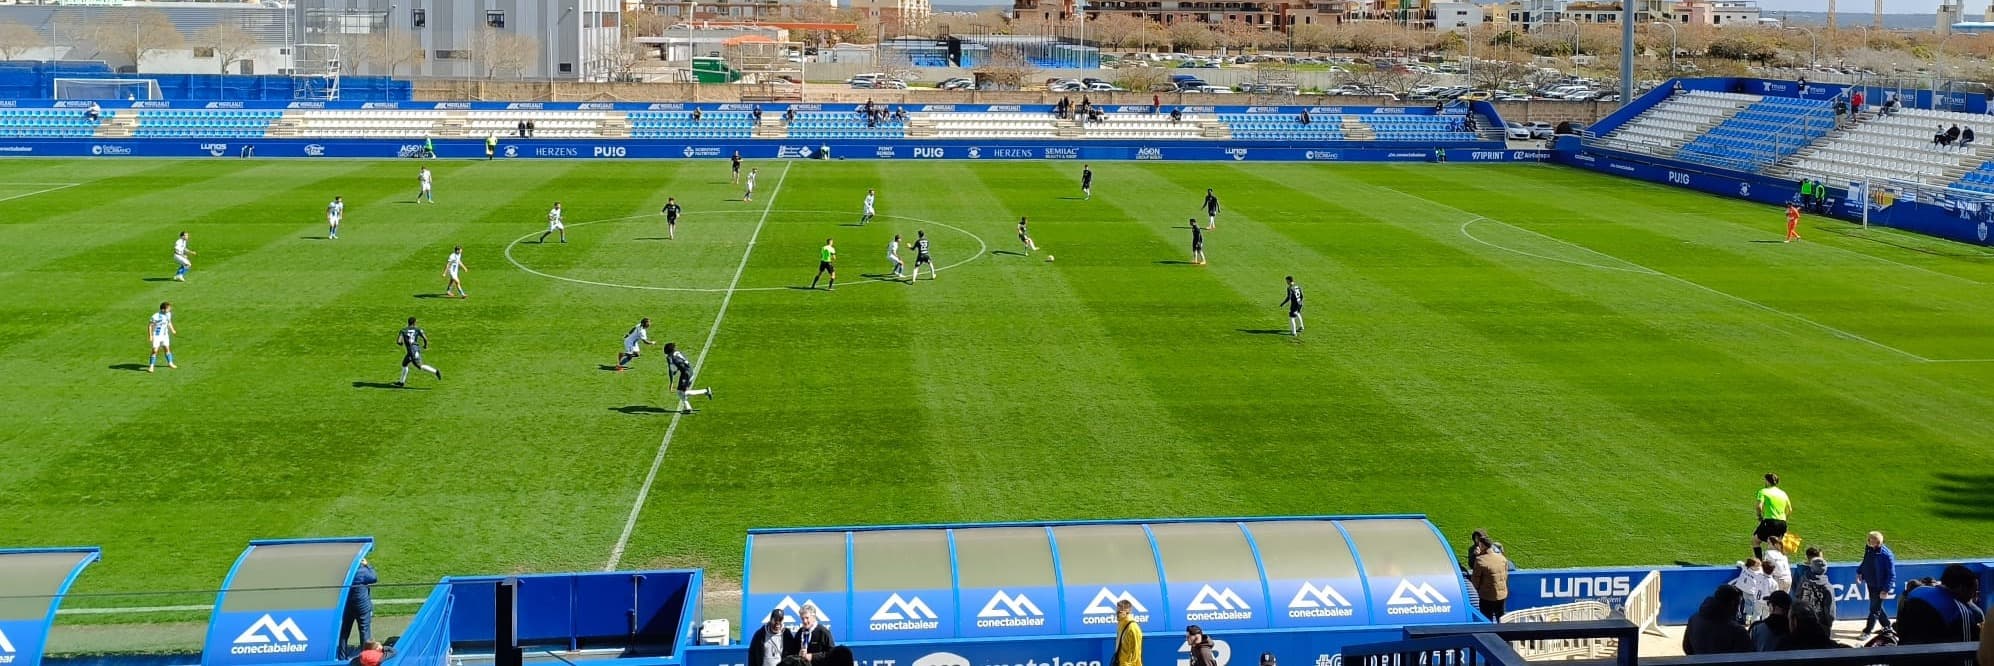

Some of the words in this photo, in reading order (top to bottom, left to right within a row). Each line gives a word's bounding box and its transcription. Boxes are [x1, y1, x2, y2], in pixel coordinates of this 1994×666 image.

[536, 147, 578, 156] HERZENS
[994, 148, 1032, 157] HERZENS
[1471, 151, 1504, 160] 971PRINT
[1540, 576, 1630, 598] LUNOS
[1289, 607, 1353, 618] conectabalear
[1387, 604, 1451, 615] conectabalear
[1186, 610, 1252, 621] conectabalear
[869, 620, 939, 631] conectabalear
[976, 616, 1045, 627] conectabalear
[231, 643, 308, 654] conectabalear
